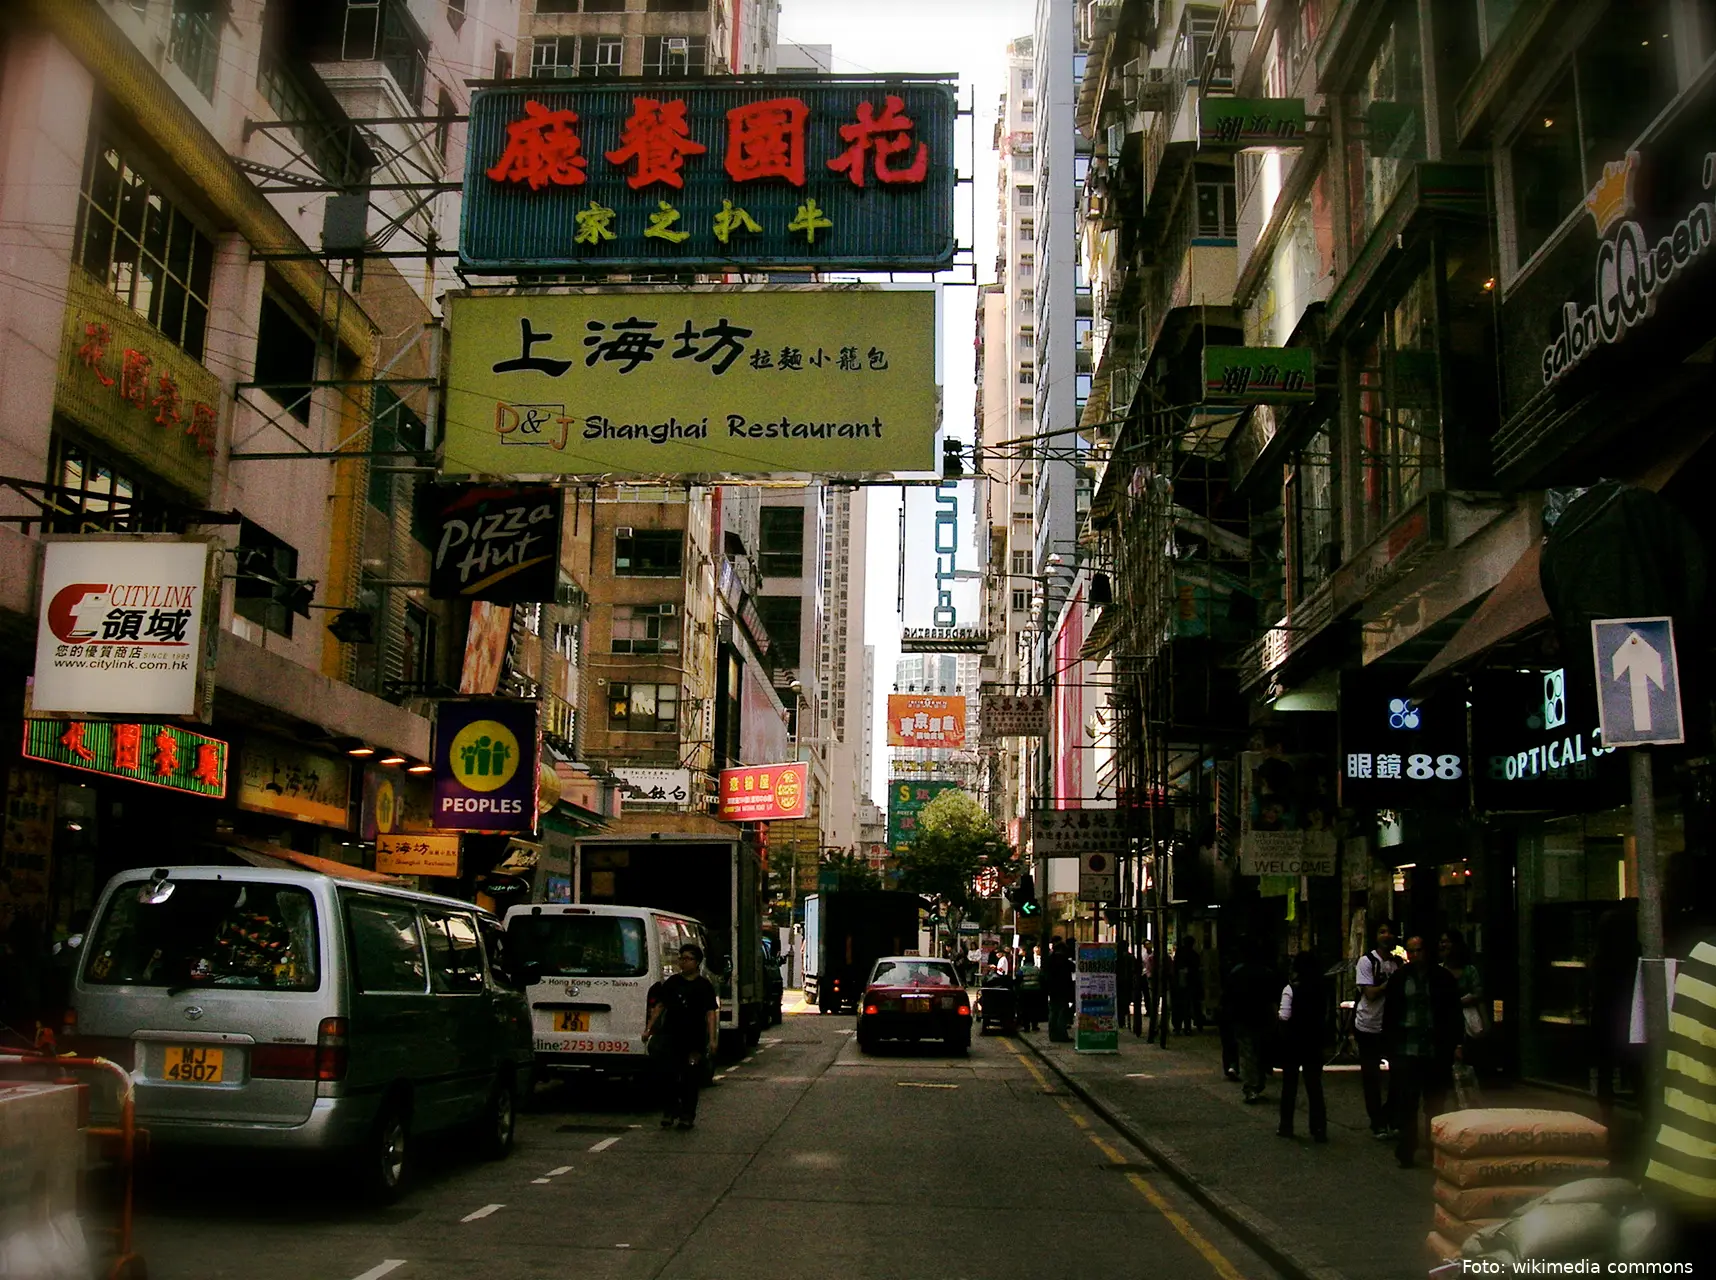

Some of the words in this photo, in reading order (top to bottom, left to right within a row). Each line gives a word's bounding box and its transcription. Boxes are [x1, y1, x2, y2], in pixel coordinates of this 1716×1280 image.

[575, 198, 831, 246] 牛扒之家
[1541, 302, 1601, 388] salon
[1595, 203, 1716, 345] GQueen
[493, 317, 753, 377] 上海坊
[751, 347, 890, 371] 拉麵小籠包
[496, 402, 575, 450] D&J
[583, 415, 708, 444] Shanghai
[727, 414, 883, 440] Restaurant
[436, 504, 555, 570] Pizza
[456, 531, 544, 583] Hut
[111, 584, 197, 608] CITYLINK
[102, 608, 191, 642] 領域
[55, 645, 143, 660] 您的優質商店
[55, 659, 189, 671] www.citylink.com.hk
[1505, 734, 1586, 780] OPTICAL
[442, 798, 523, 814] PEOPLES
[378, 841, 430, 856] 上海坊
[1254, 861, 1331, 873] WELCOME
[548, 978, 570, 988] Hong
[571, 978, 592, 988] Kong
[612, 980, 640, 988] Taiwan
[182, 1049, 207, 1064] MJ
[598, 1041, 631, 1053] 0392
[168, 1063, 218, 1081] 4907
